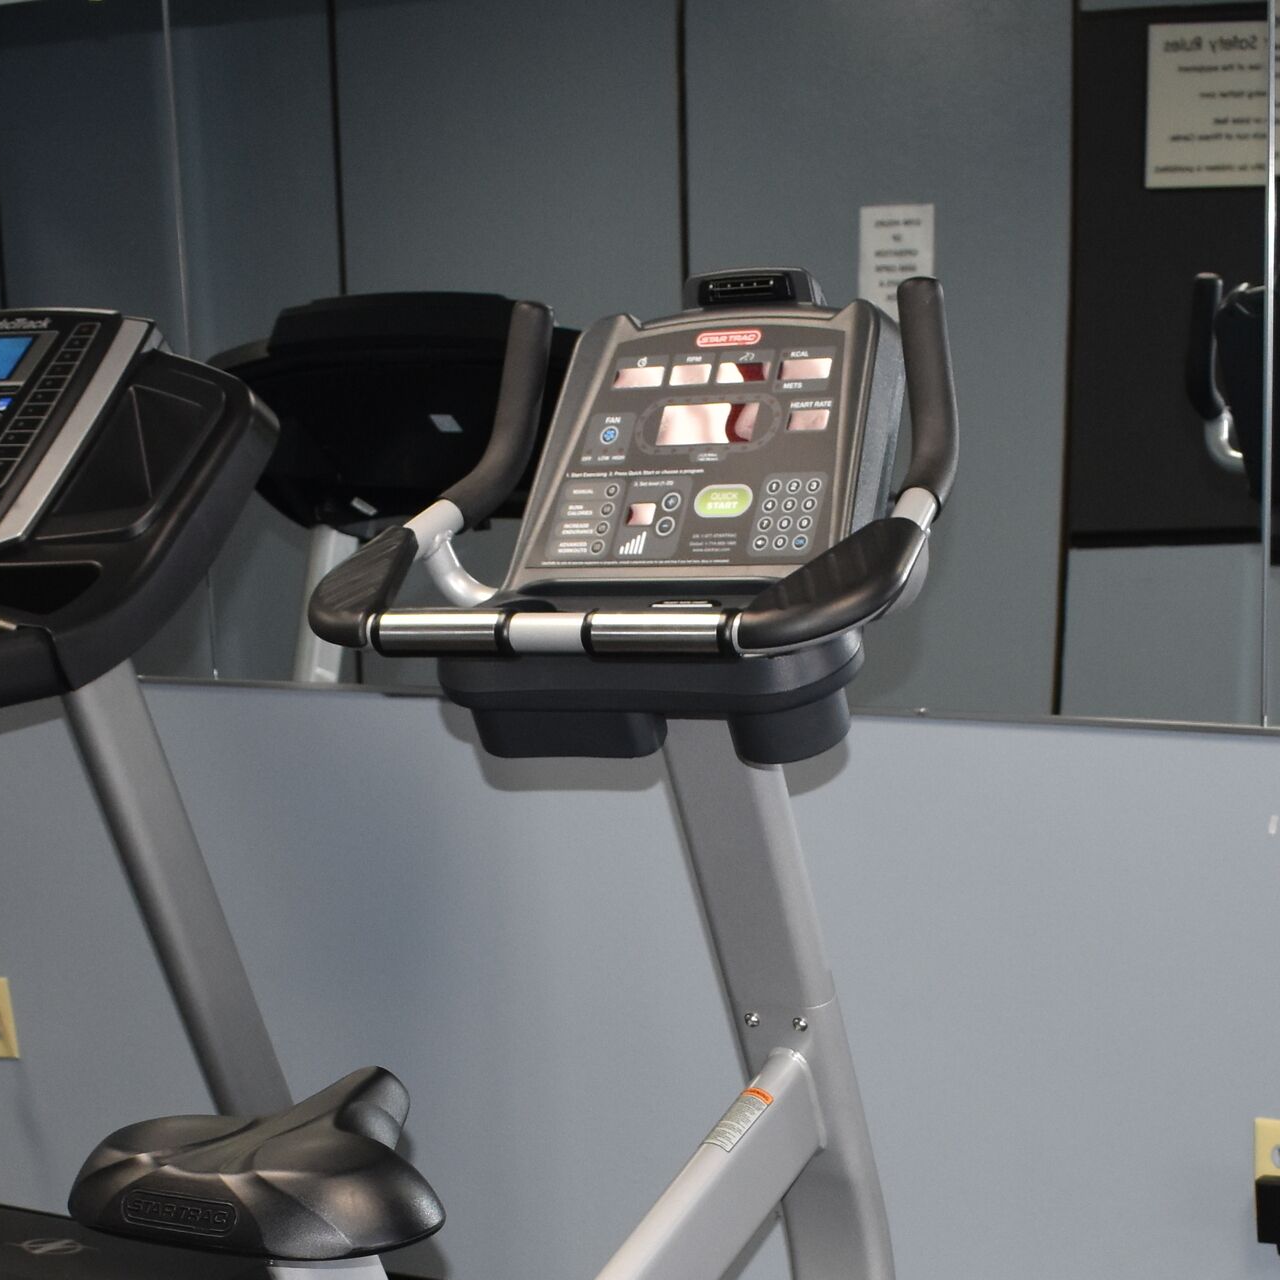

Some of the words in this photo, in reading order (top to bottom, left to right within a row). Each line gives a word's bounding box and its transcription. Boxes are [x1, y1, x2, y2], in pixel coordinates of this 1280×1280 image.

[700, 334, 728, 344] STAR
[728, 333, 756, 343] TRAC
[790, 350, 809, 358] KCAL
[783, 382, 802, 390] METS
[790, 401, 814, 409] HEART
[814, 400, 833, 409] RATE
[605, 416, 621, 424] FAN
[706, 501, 739, 510] START
[126, 1200, 177, 1217] STAR
[180, 1205, 228, 1223] TRAC
